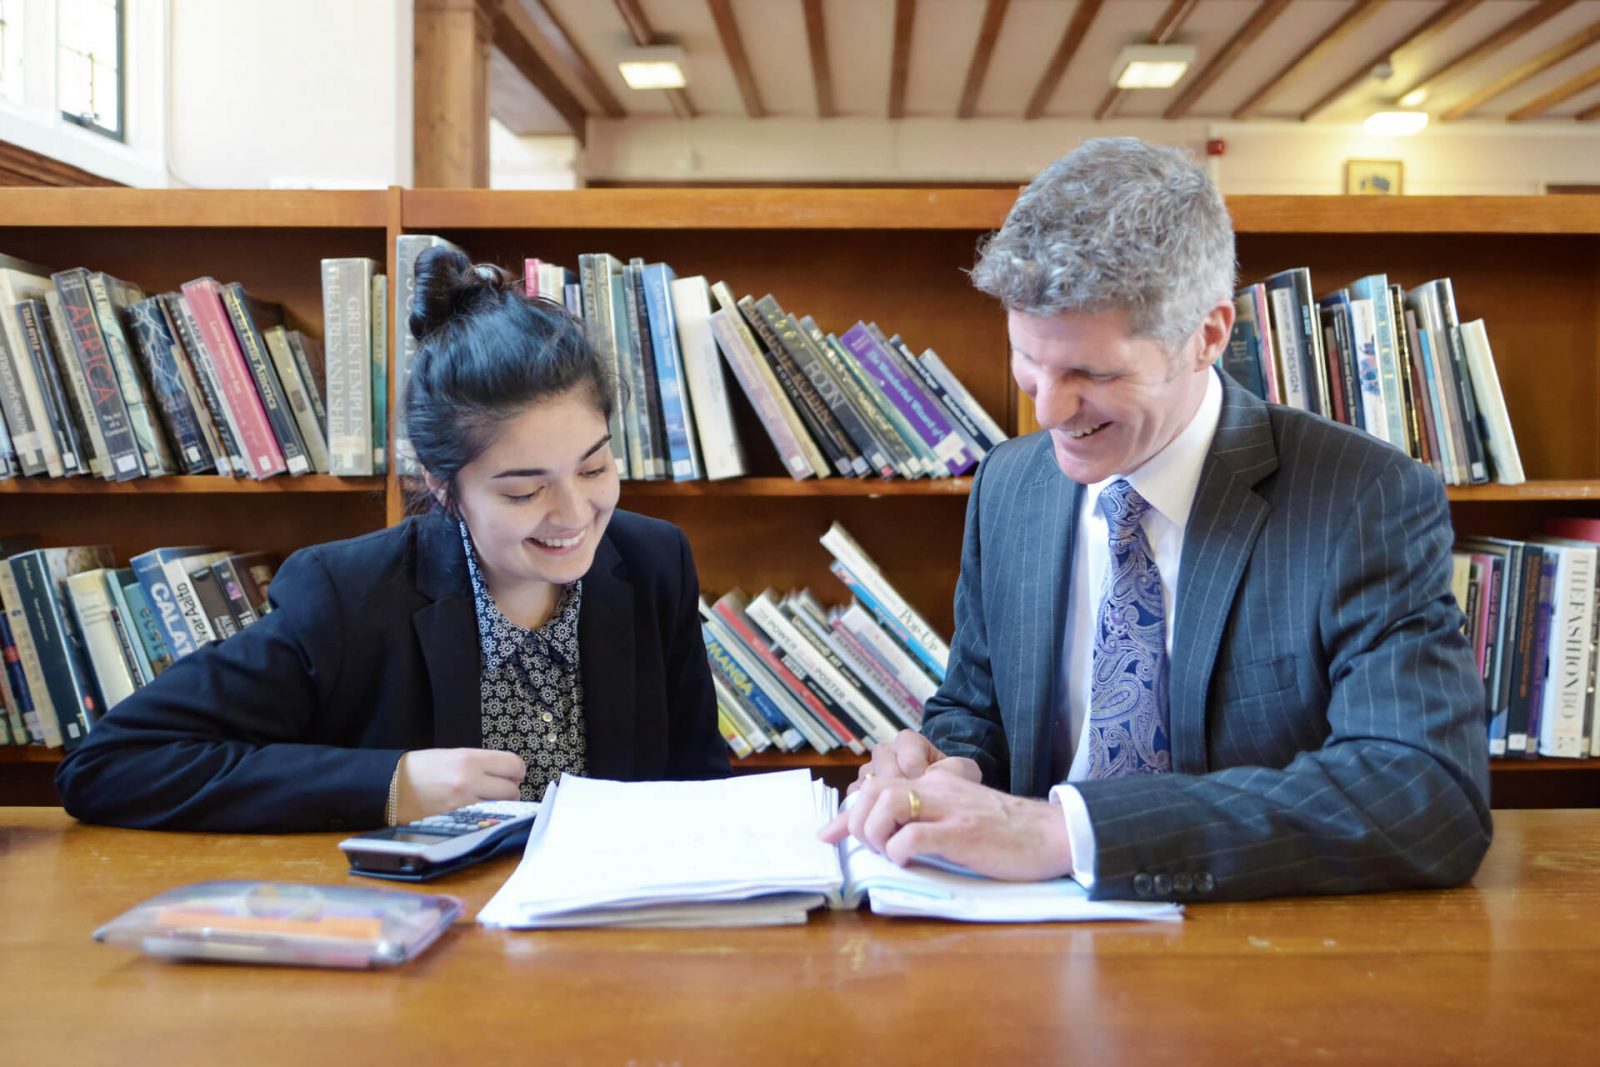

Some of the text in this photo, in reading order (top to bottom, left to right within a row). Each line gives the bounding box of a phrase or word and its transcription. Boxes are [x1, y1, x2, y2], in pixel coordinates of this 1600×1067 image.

[20, 306, 40, 350] THAI STYLE
[229, 296, 245, 317] Art
[236, 316, 250, 330] in
[326, 264, 342, 353] THEATRES
[63, 297, 120, 405] AFRICA
[208, 319, 222, 342] Latin
[217, 340, 236, 380] American
[231, 379, 243, 395] Art
[242, 330, 261, 360] Latin
[346, 296, 364, 434] GREEK TEMPLES
[742, 301, 796, 371] AUGUSTE
[791, 370, 834, 424] RODIN
[1285, 346, 1300, 394] DESIGN
[253, 361, 280, 410] America
[330, 355, 344, 393] AND
[876, 360, 915, 403] Wonderful
[909, 398, 936, 429] Wizard
[176, 582, 200, 617] Aalto
[1569, 558, 1587, 600] THE
[151, 582, 194, 656] CALAT
[1563, 600, 1584, 689] FASHION
[704, 639, 756, 696] MANGA
[765, 618, 797, 651] POWER
[813, 665, 846, 700] POSTER
